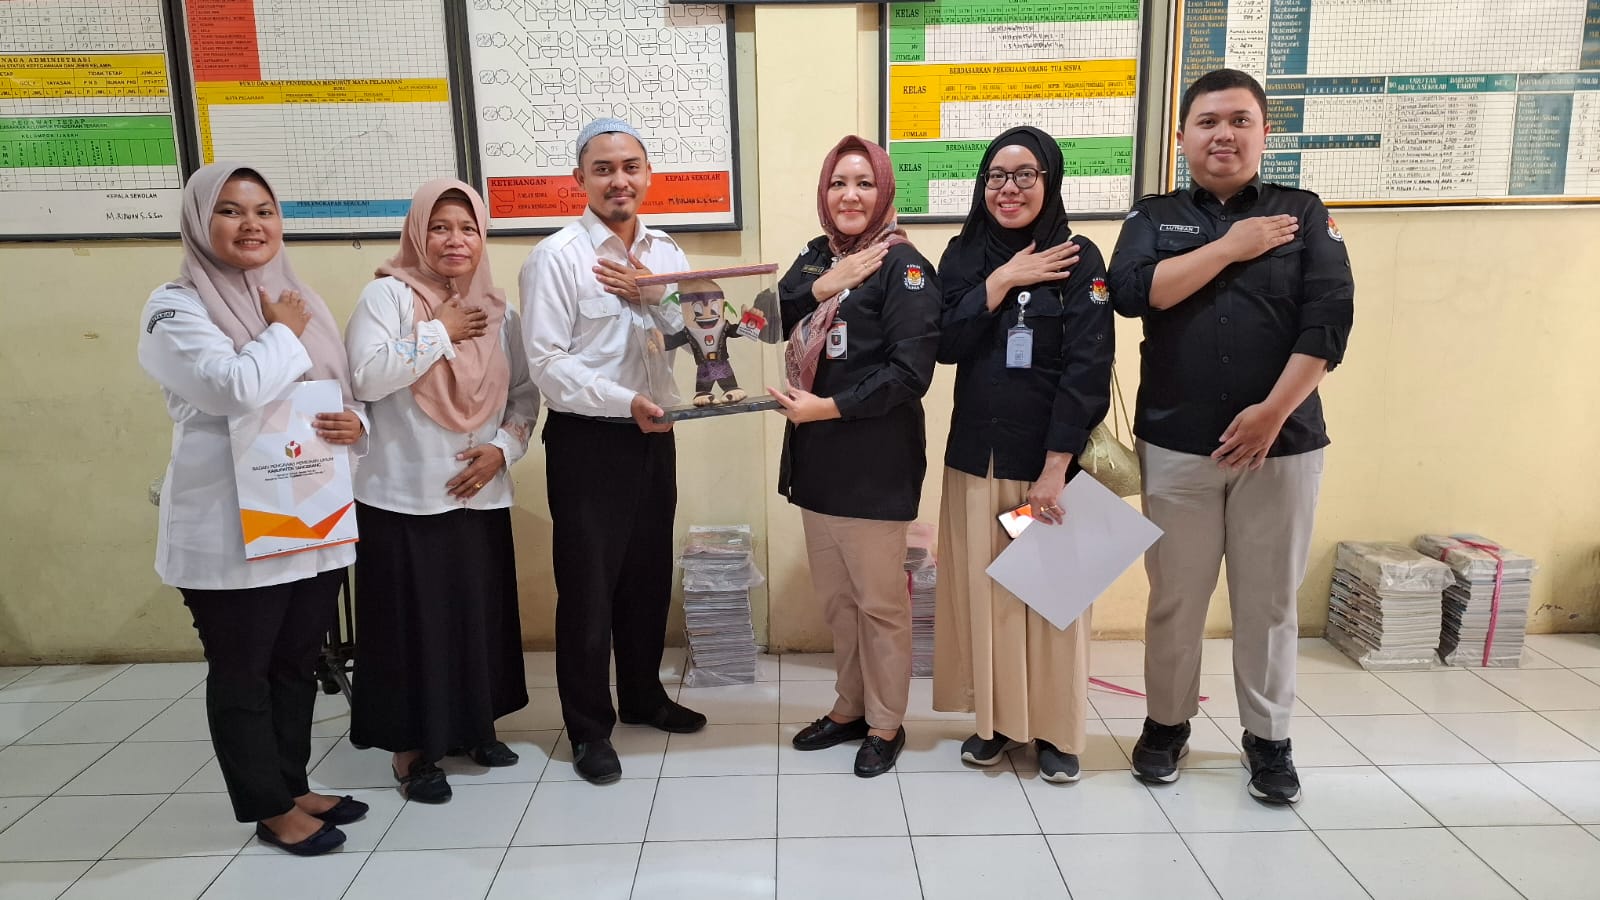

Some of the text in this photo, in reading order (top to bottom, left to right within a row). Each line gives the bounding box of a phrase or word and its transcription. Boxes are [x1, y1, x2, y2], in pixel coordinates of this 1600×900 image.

[895, 9, 919, 18] KELAS
[903, 85, 927, 94] KELAS
[898, 163, 922, 172] KELAS
[491, 178, 547, 187] KETERANGAN
